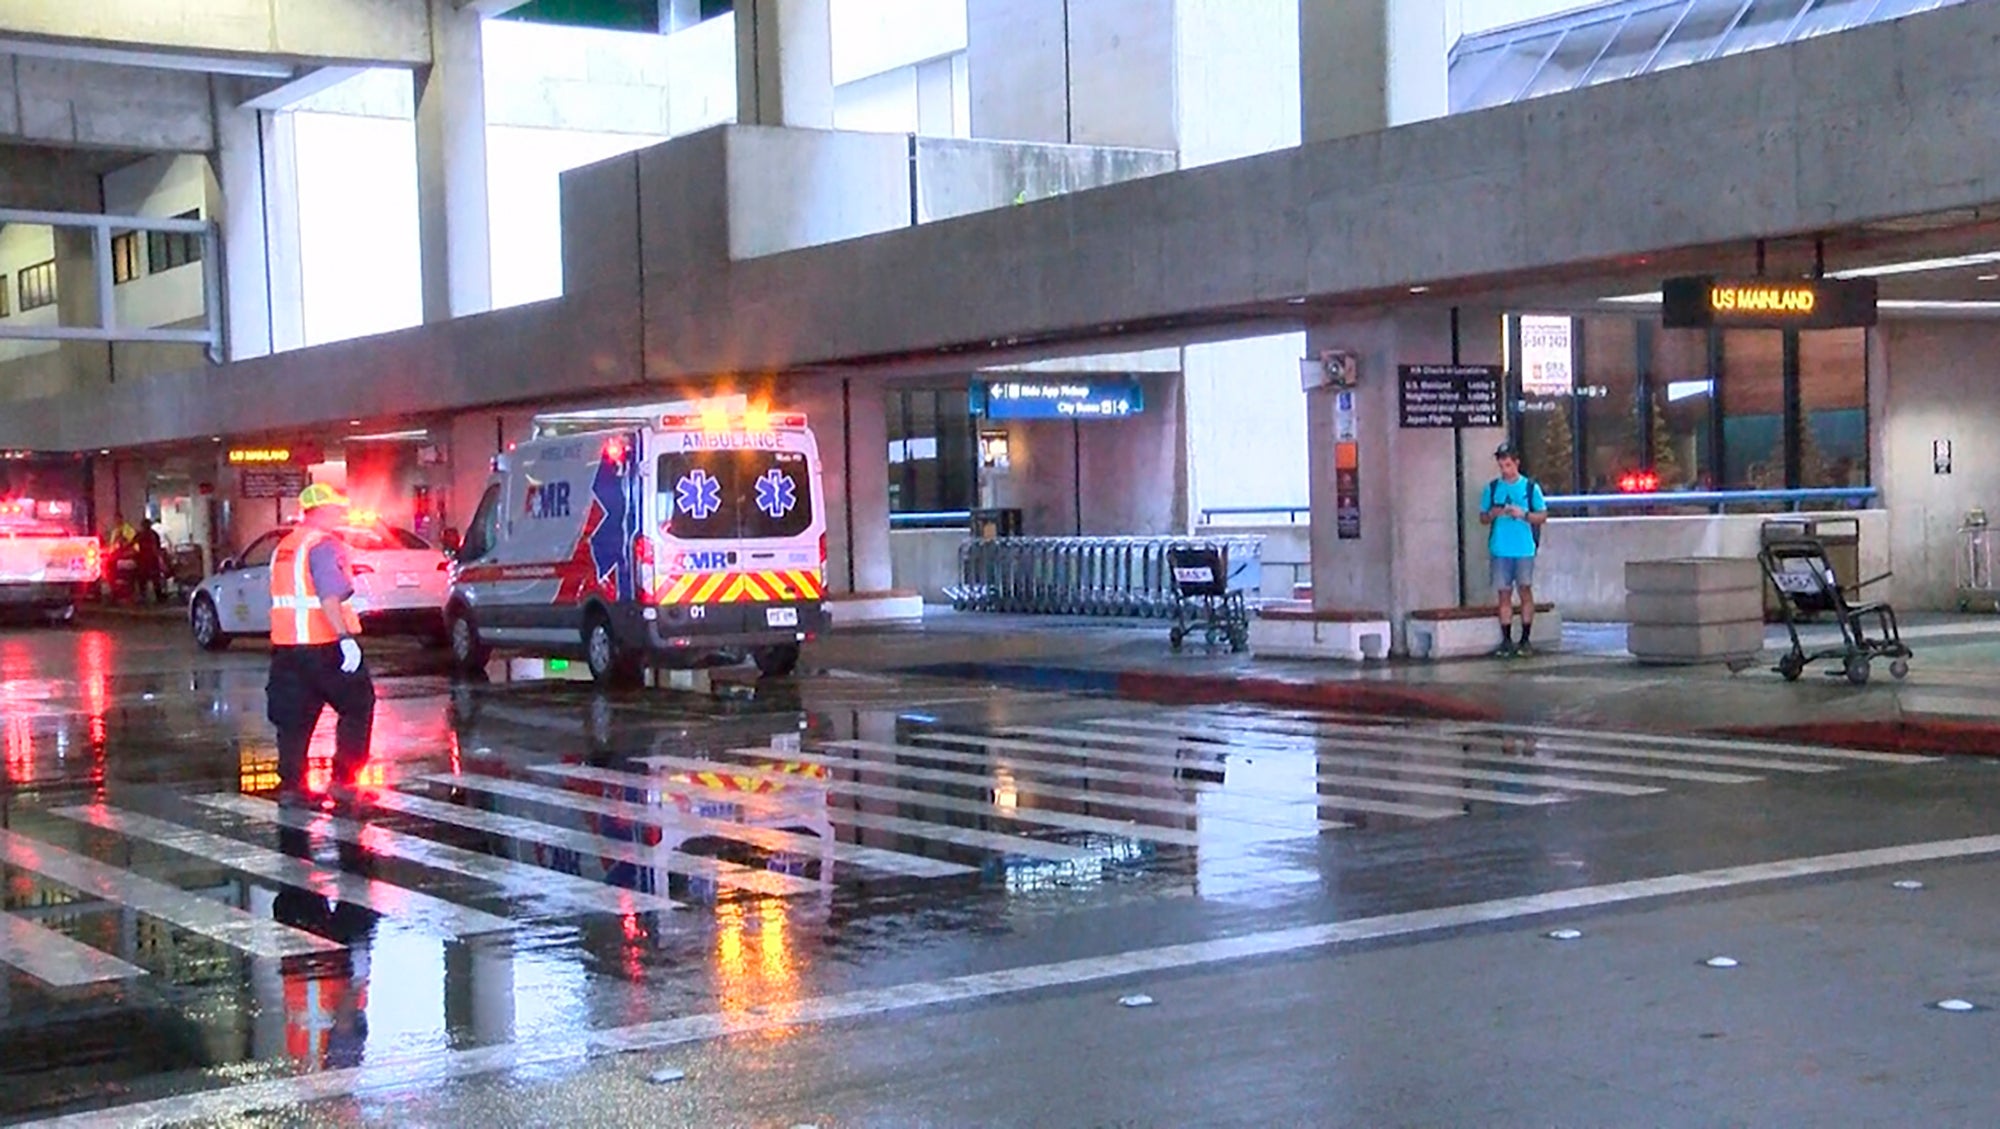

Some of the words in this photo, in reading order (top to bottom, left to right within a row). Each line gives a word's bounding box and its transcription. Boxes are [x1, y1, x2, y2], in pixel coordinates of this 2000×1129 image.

[1712, 289, 1735, 310] US
[1736, 289, 1814, 311] MAINLAND
[1021, 385, 1040, 398] Ride
[1041, 386, 1059, 399] App
[1060, 385, 1089, 399] Pickup
[1467, 381, 1489, 391] Lobby
[1467, 392, 1490, 402] Lobby
[1057, 401, 1076, 415] City
[1468, 415, 1490, 425] Lobby
[682, 432, 785, 449] AMBULANCE
[690, 606, 705, 618] 01
